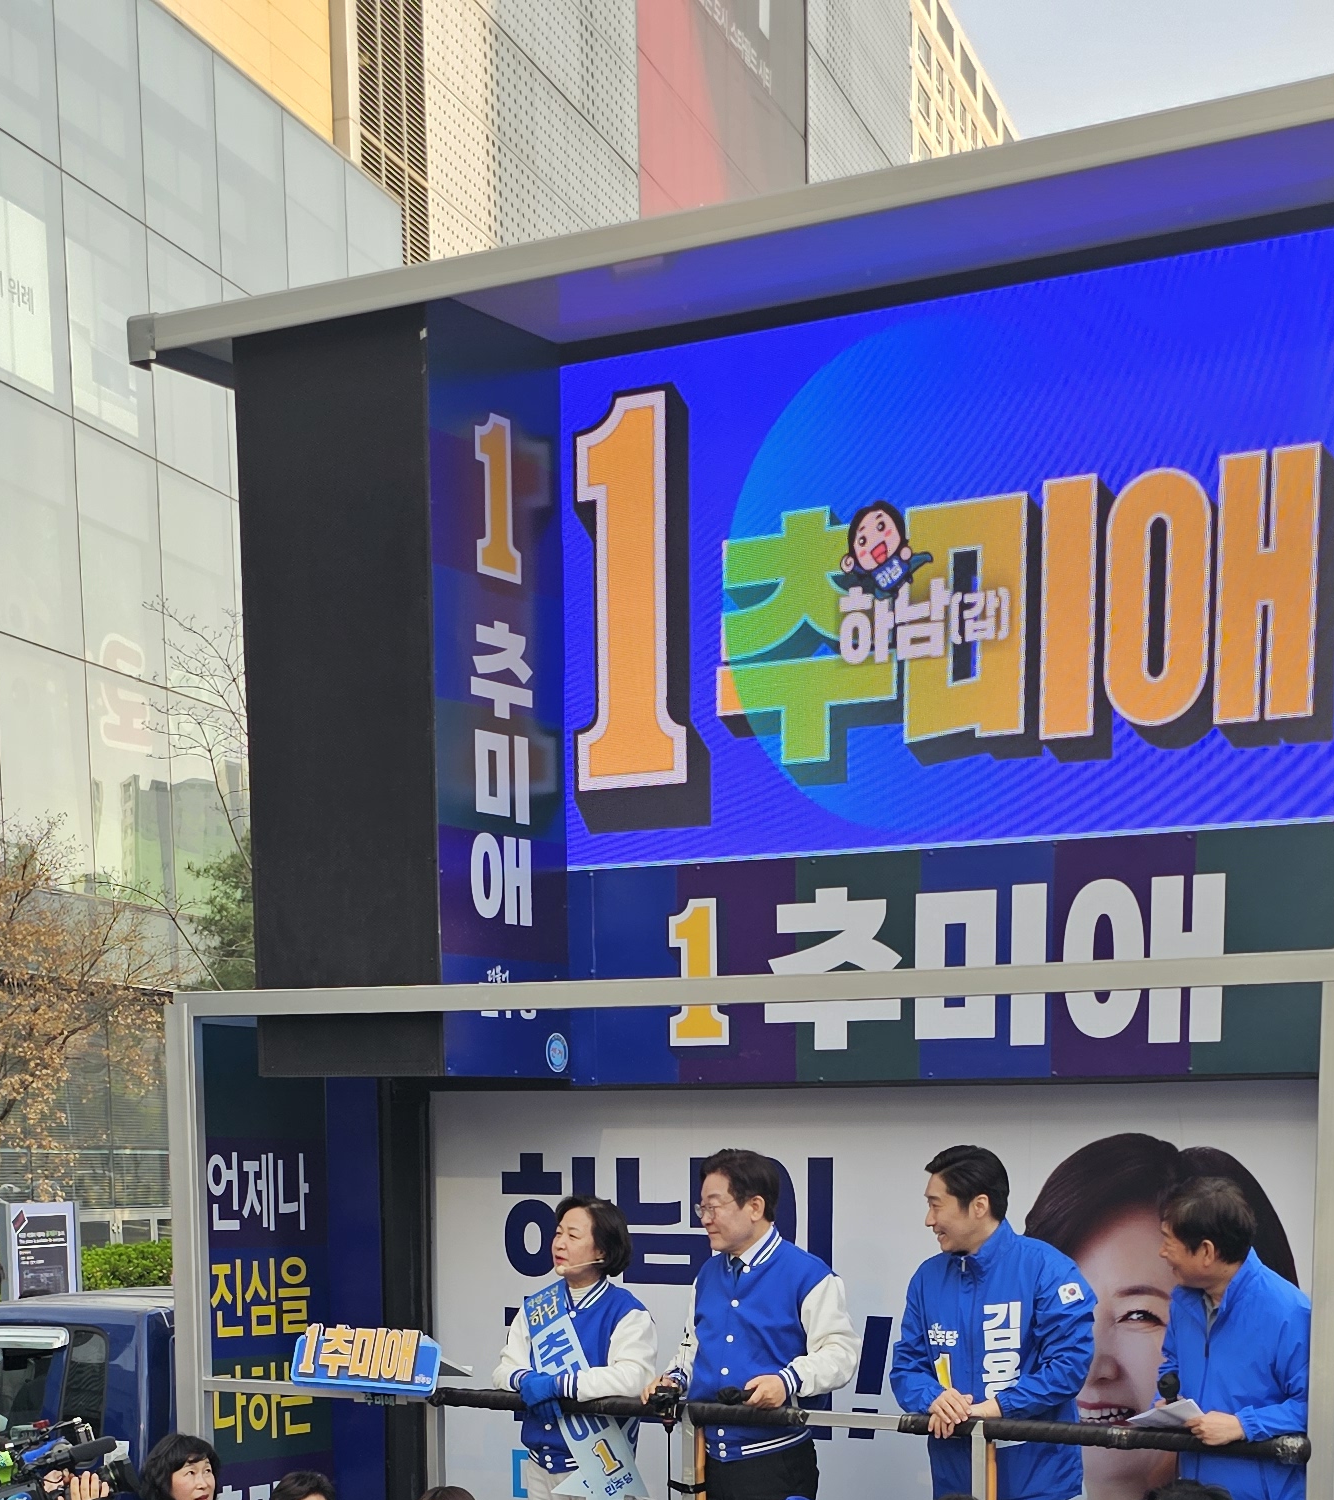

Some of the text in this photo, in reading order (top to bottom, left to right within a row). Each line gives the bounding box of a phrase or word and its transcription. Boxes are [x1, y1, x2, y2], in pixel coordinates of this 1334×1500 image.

[7, 277, 35, 316] 위례
[716, 440, 1322, 765] 추미애
[838, 577, 1011, 665] 하남(갑)
[469, 618, 534, 928] 추미애
[764, 872, 1227, 1051] 추미애
[206, 1151, 310, 1232] 언제나
[210, 1255, 311, 1338] 진심을
[529, 1295, 560, 1327] 하남
[318, 1323, 421, 1383] 추미애
[928, 1329, 959, 1347] 민주당
[981, 1300, 1022, 1401] 김용
[591, 1438, 624, 1477] 1
[604, 1472, 634, 1497] 민주당
